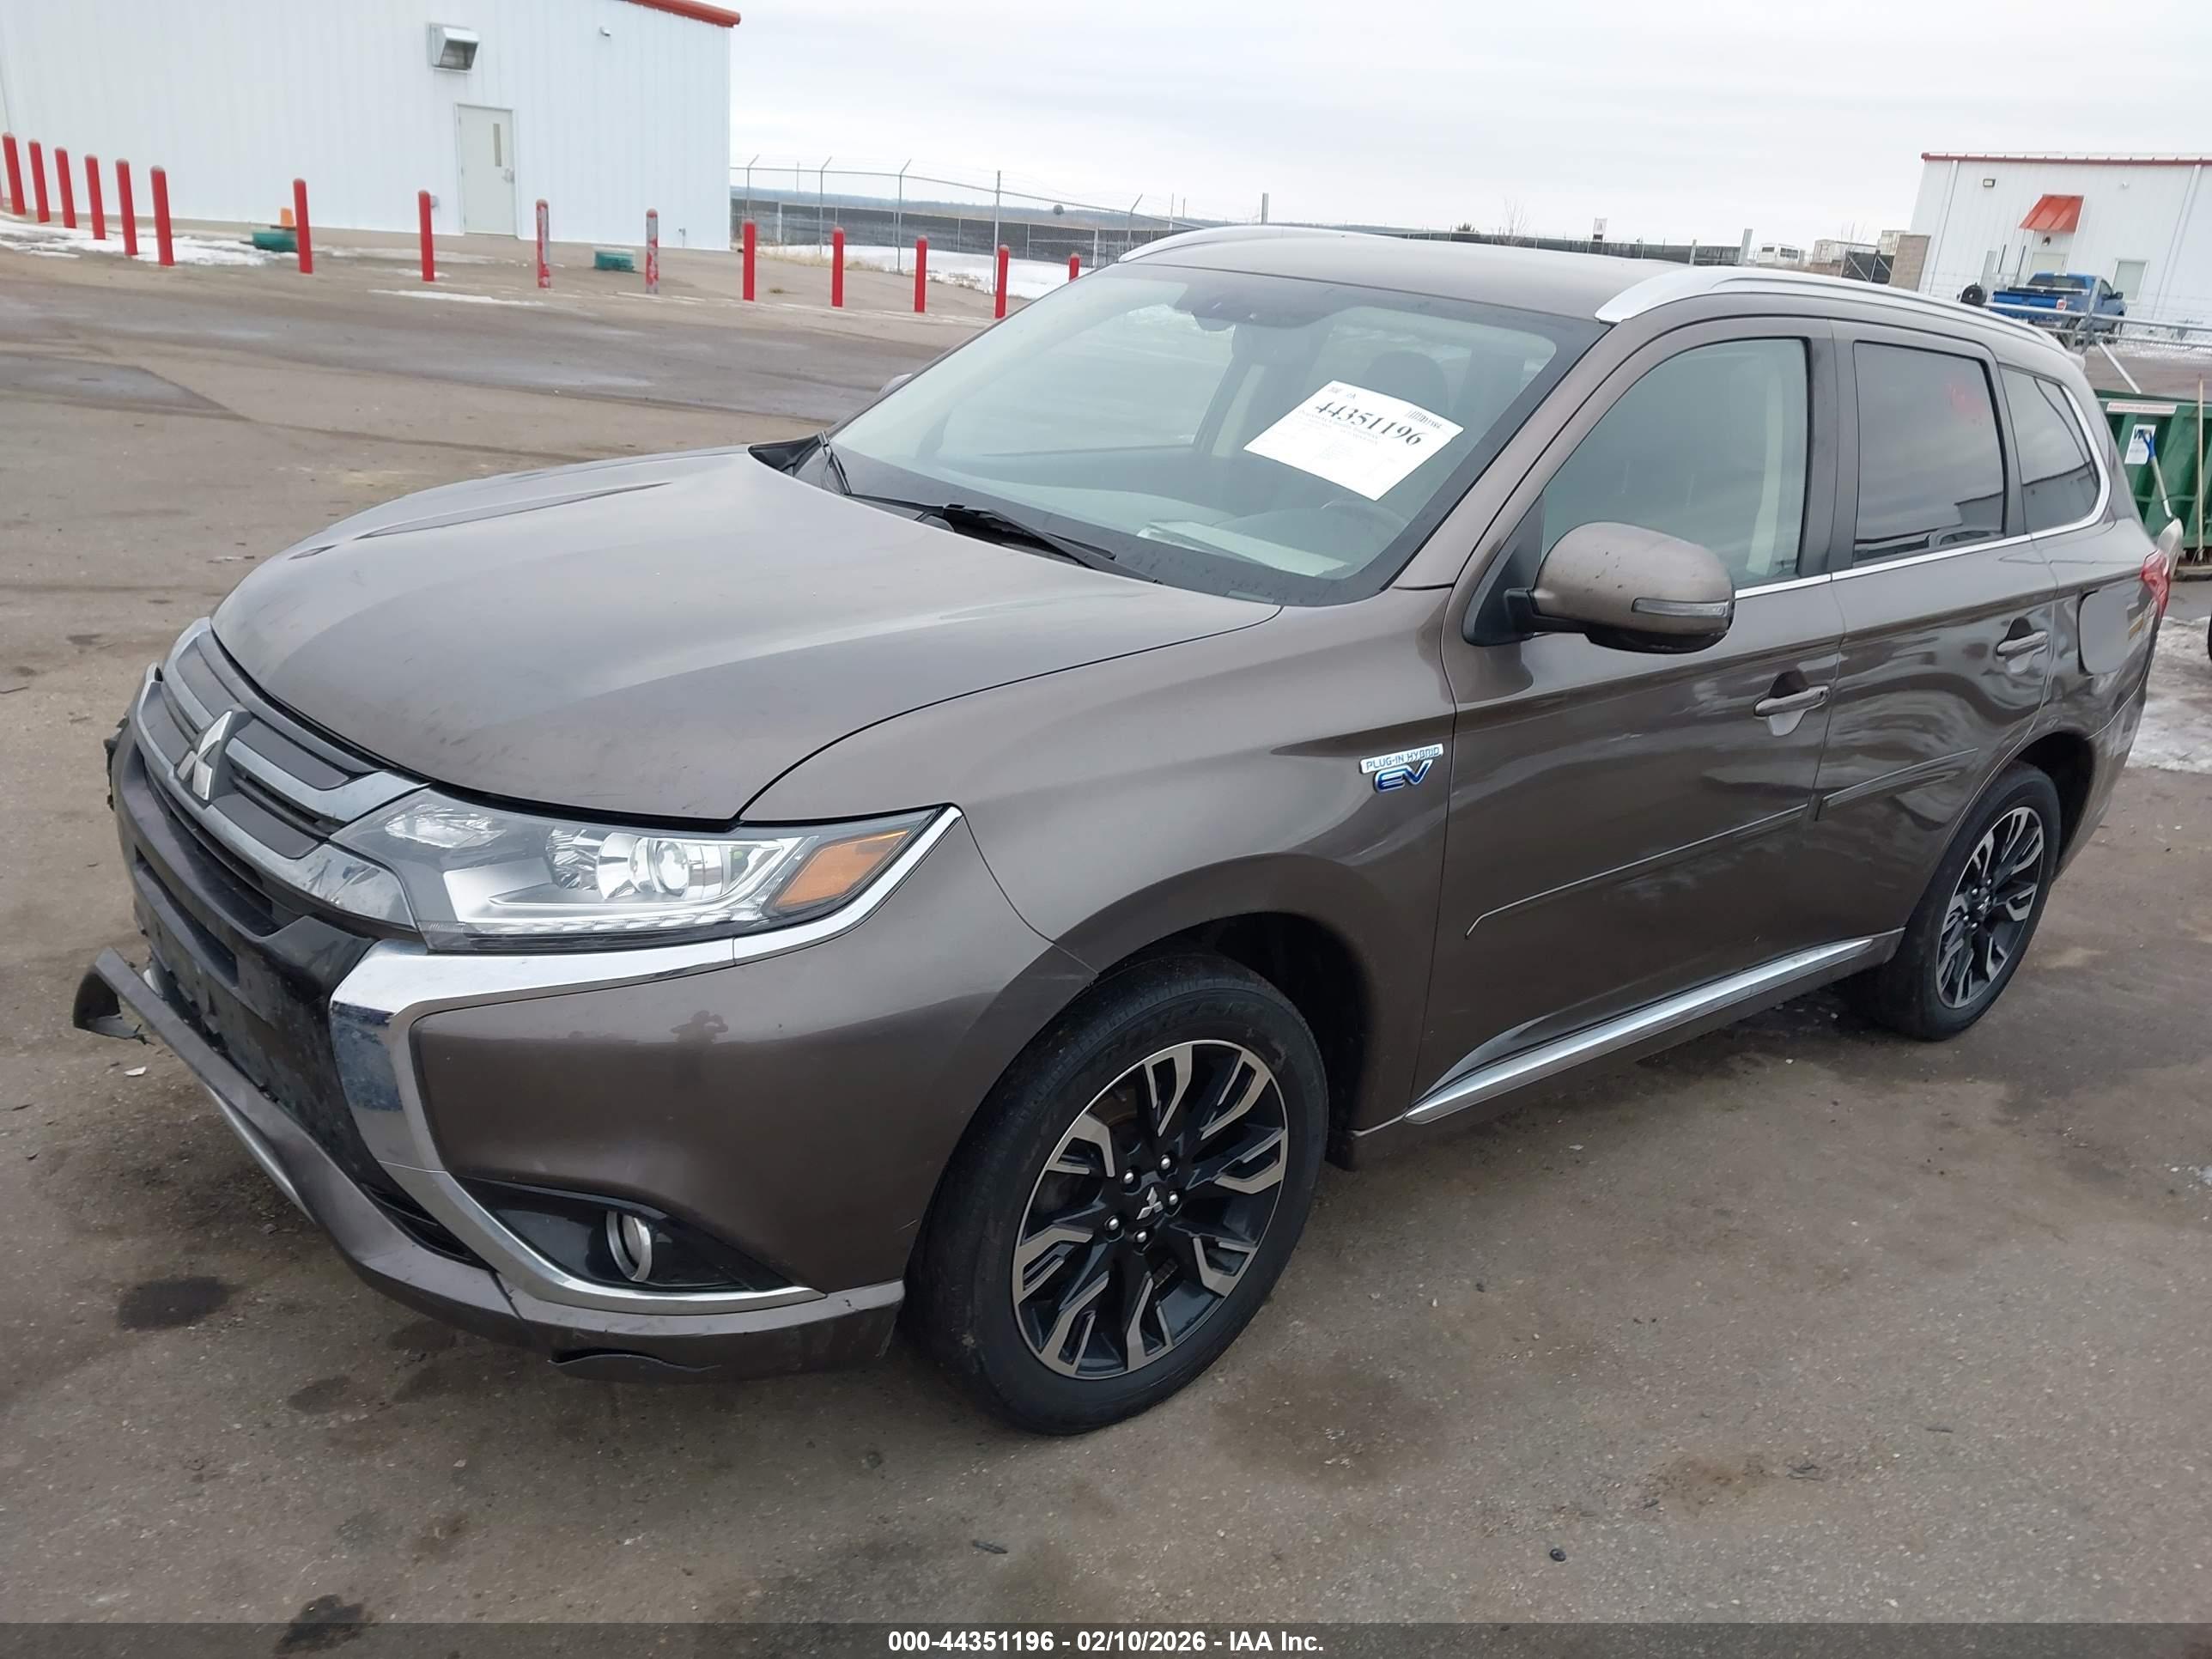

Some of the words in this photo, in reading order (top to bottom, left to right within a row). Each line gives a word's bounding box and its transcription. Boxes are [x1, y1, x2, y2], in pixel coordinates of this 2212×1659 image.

[1316, 401, 1429, 447] 44351196
[1365, 755, 1405, 771] PLUG-IN
[1407, 746, 1441, 763] HYBRID
[1374, 759, 1433, 793] EV
